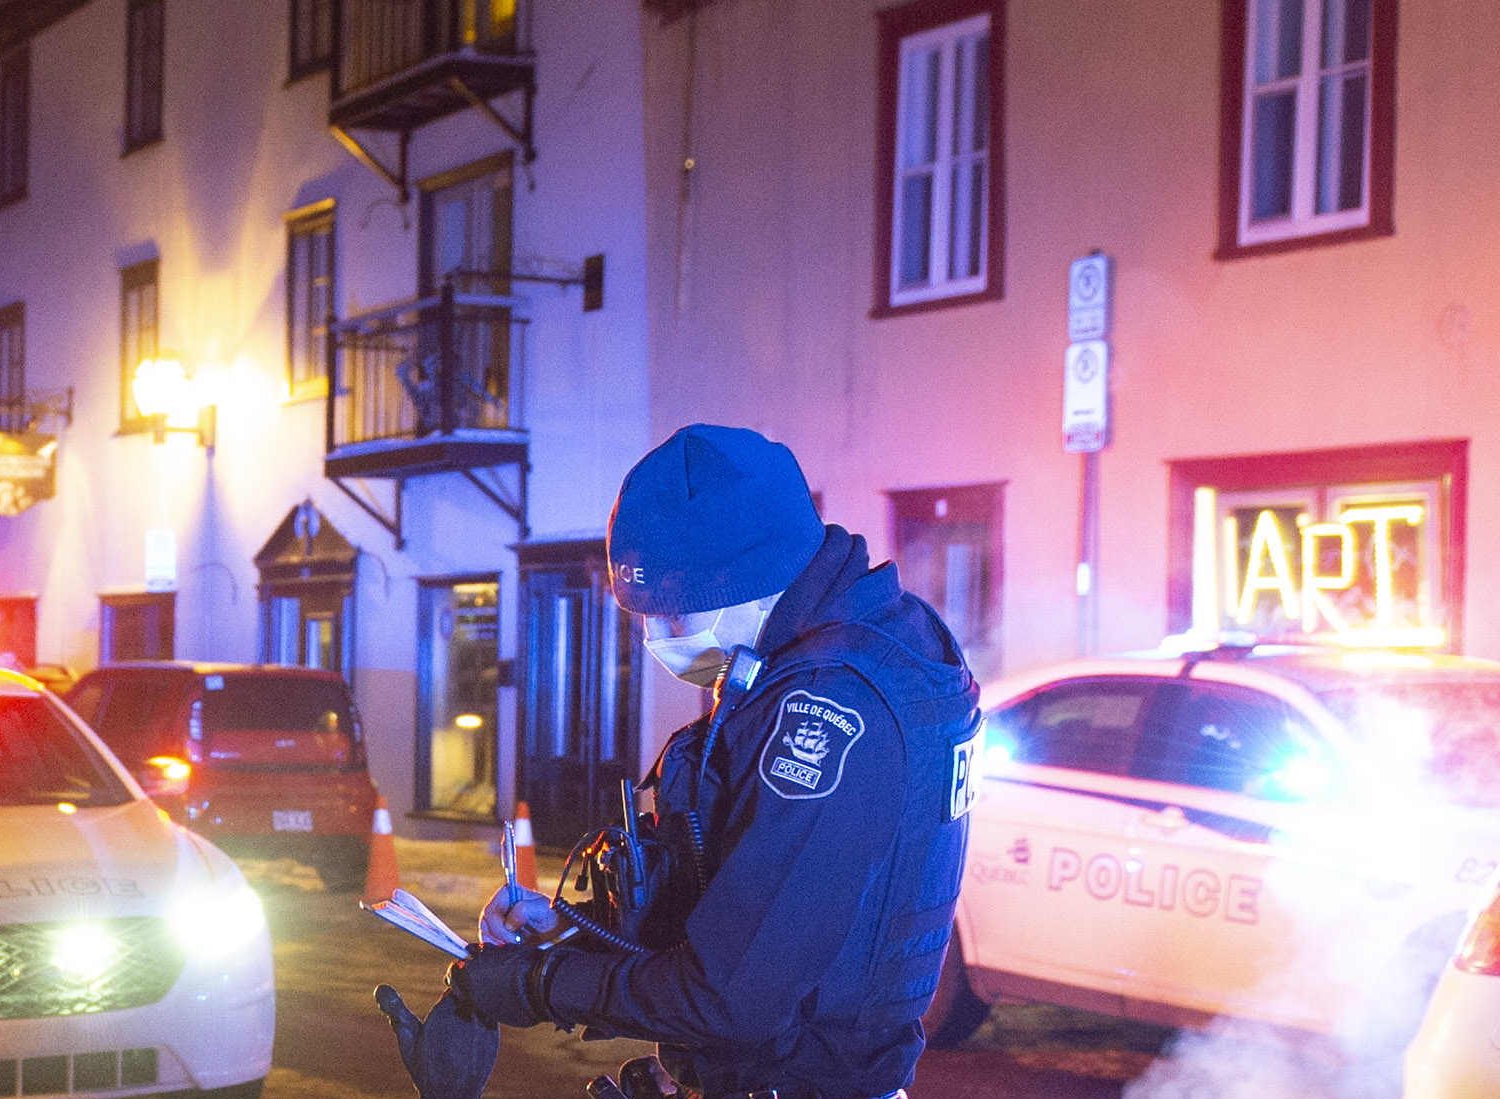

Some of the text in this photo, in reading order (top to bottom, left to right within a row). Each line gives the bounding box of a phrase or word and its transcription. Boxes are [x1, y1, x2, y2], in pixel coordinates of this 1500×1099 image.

[1235, 505, 1425, 636] ART
[786, 702, 856, 736] VILLE DE QUÉBEC
[778, 762, 814, 783] POLICE
[1047, 846, 1263, 925] POLICE
